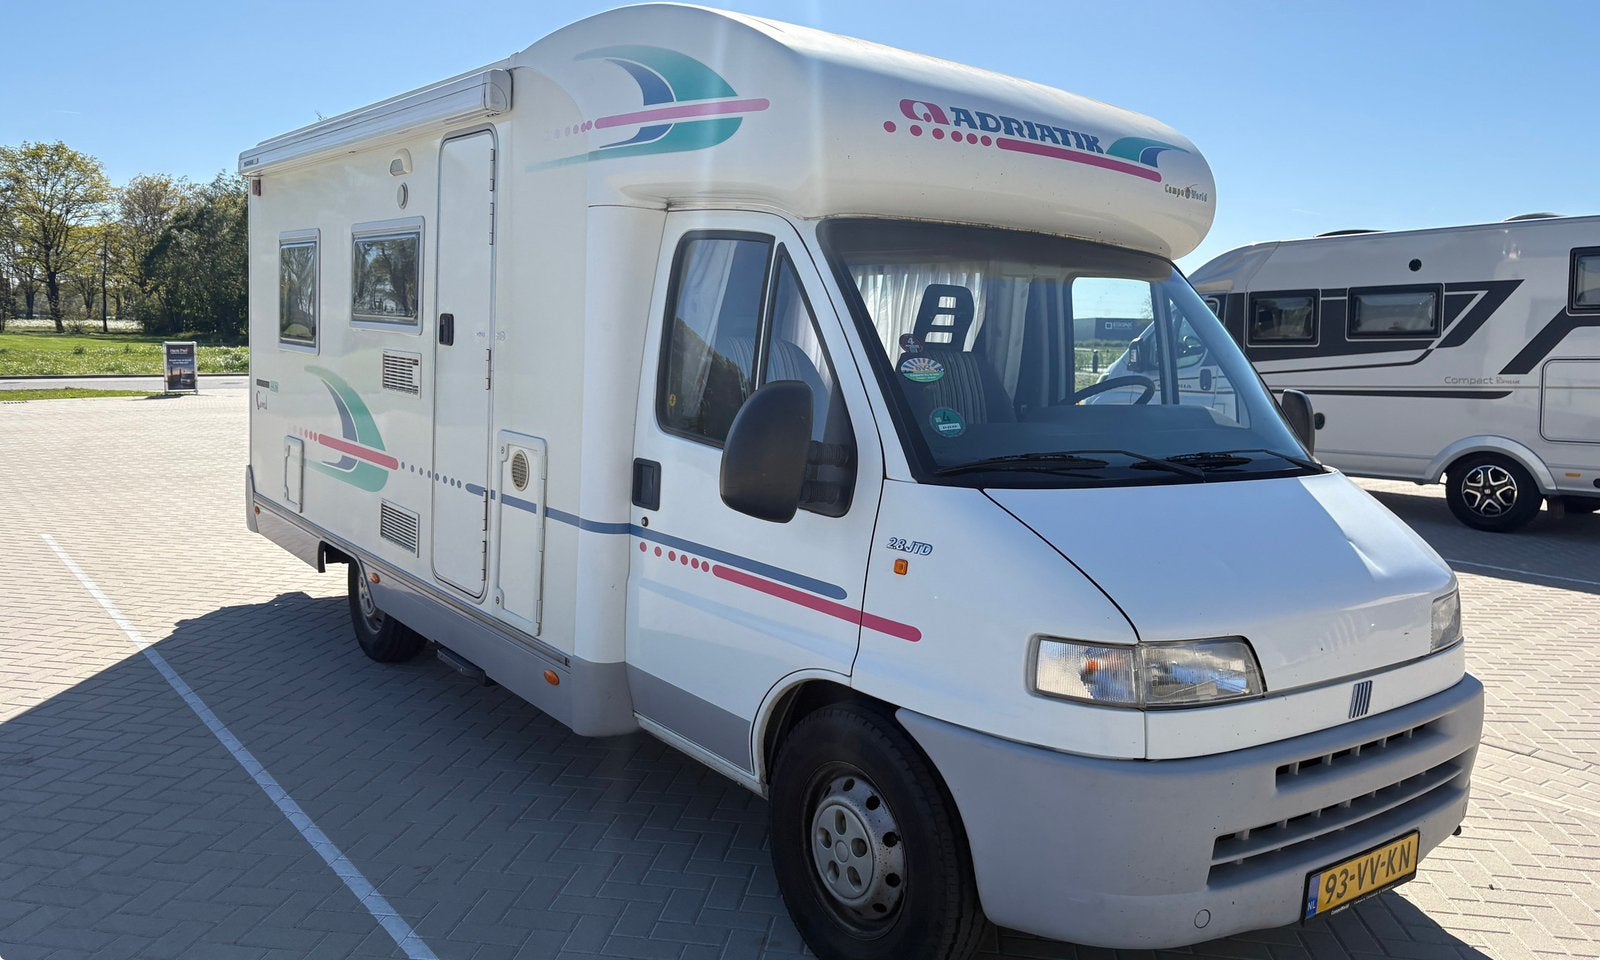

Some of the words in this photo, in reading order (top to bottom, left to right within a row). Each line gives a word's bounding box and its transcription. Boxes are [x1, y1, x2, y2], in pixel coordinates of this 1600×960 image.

[950, 106, 1103, 154] ADRIATIK
[1444, 376, 1494, 385] Compact
[905, 540, 933, 556] JTD
[1325, 841, 1411, 905] 93-VV-KN
[1307, 898, 1316, 911] NL
